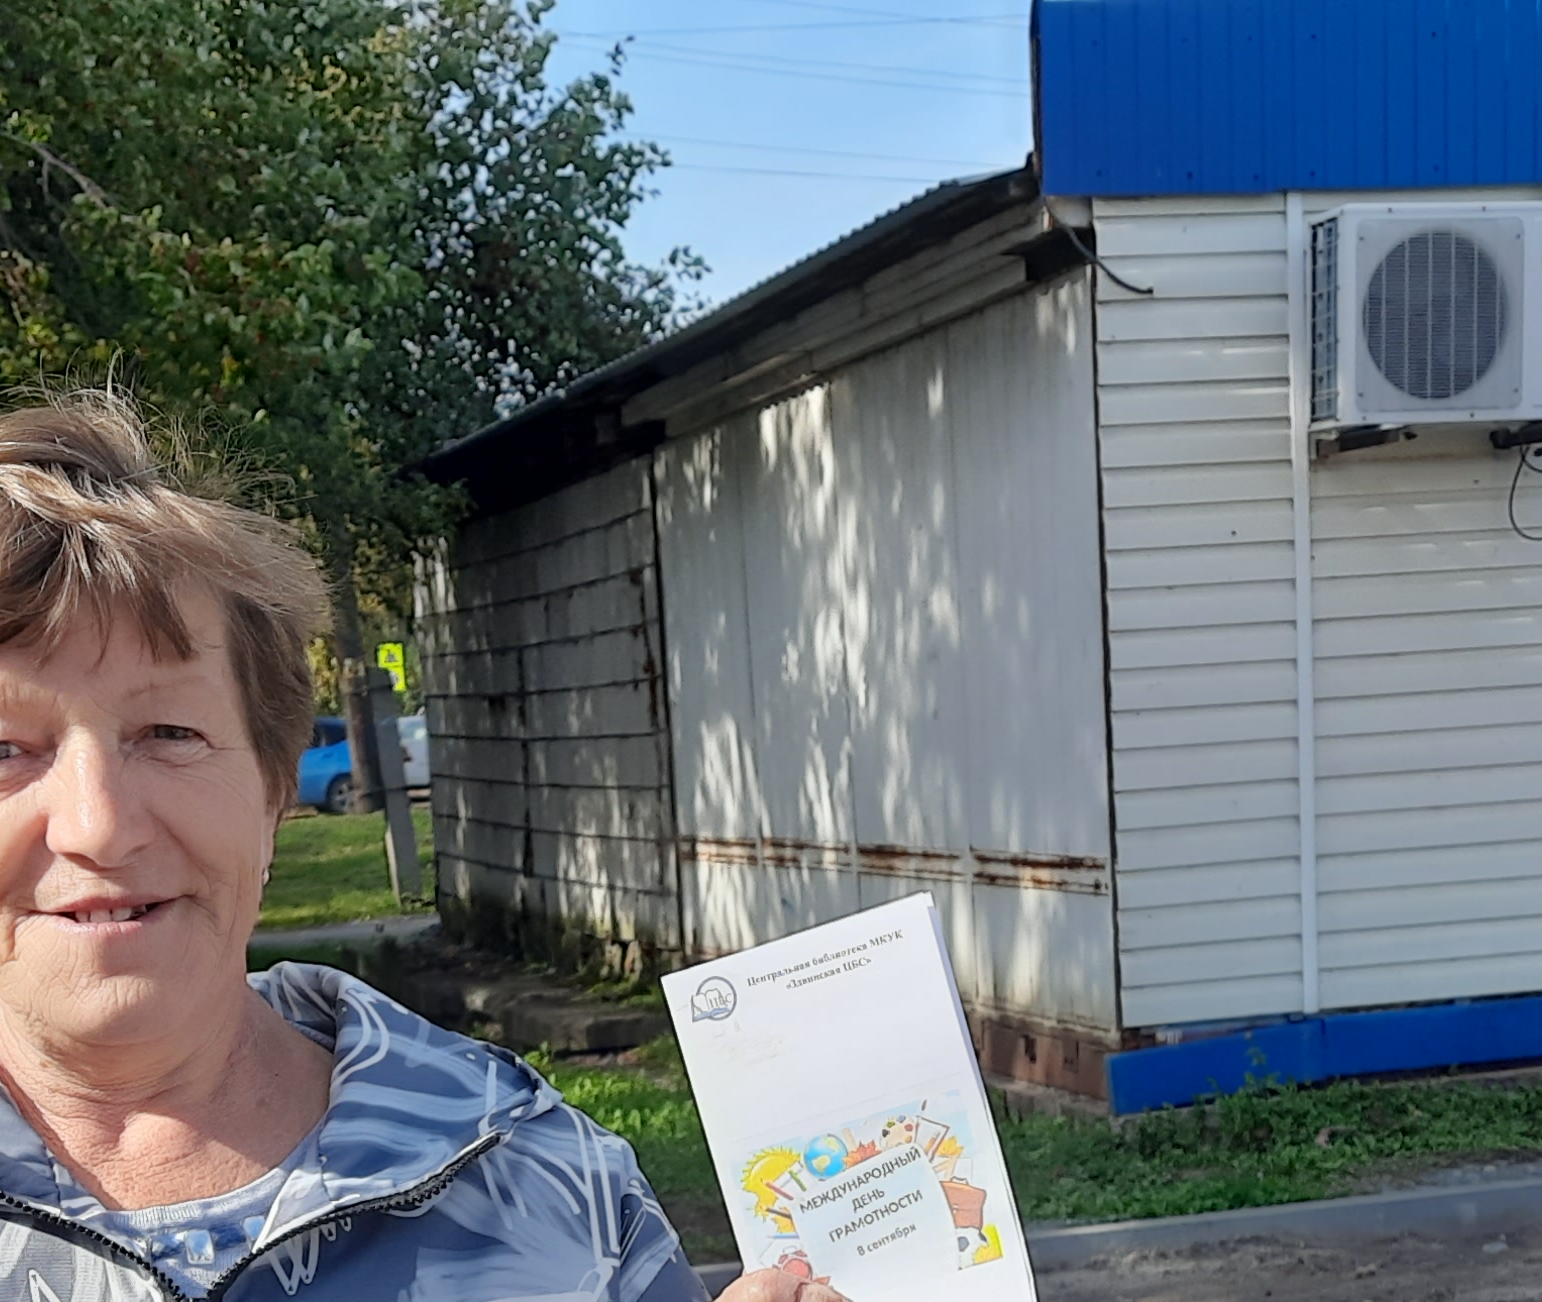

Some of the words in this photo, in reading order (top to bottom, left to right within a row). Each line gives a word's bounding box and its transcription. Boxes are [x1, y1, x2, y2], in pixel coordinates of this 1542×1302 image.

[747, 961, 811, 986] Центральная
[812, 943, 868, 967] библиотека
[869, 929, 904, 948] МКУК
[799, 1146, 922, 1214] МЕЖДУНАРОДНЫЙ
[852, 1188, 885, 1213] ДЕНЬ
[828, 1190, 923, 1242] ГРАМОТНОСТИ
[857, 1245, 866, 1257] 8
[867, 1223, 917, 1252] сентября
